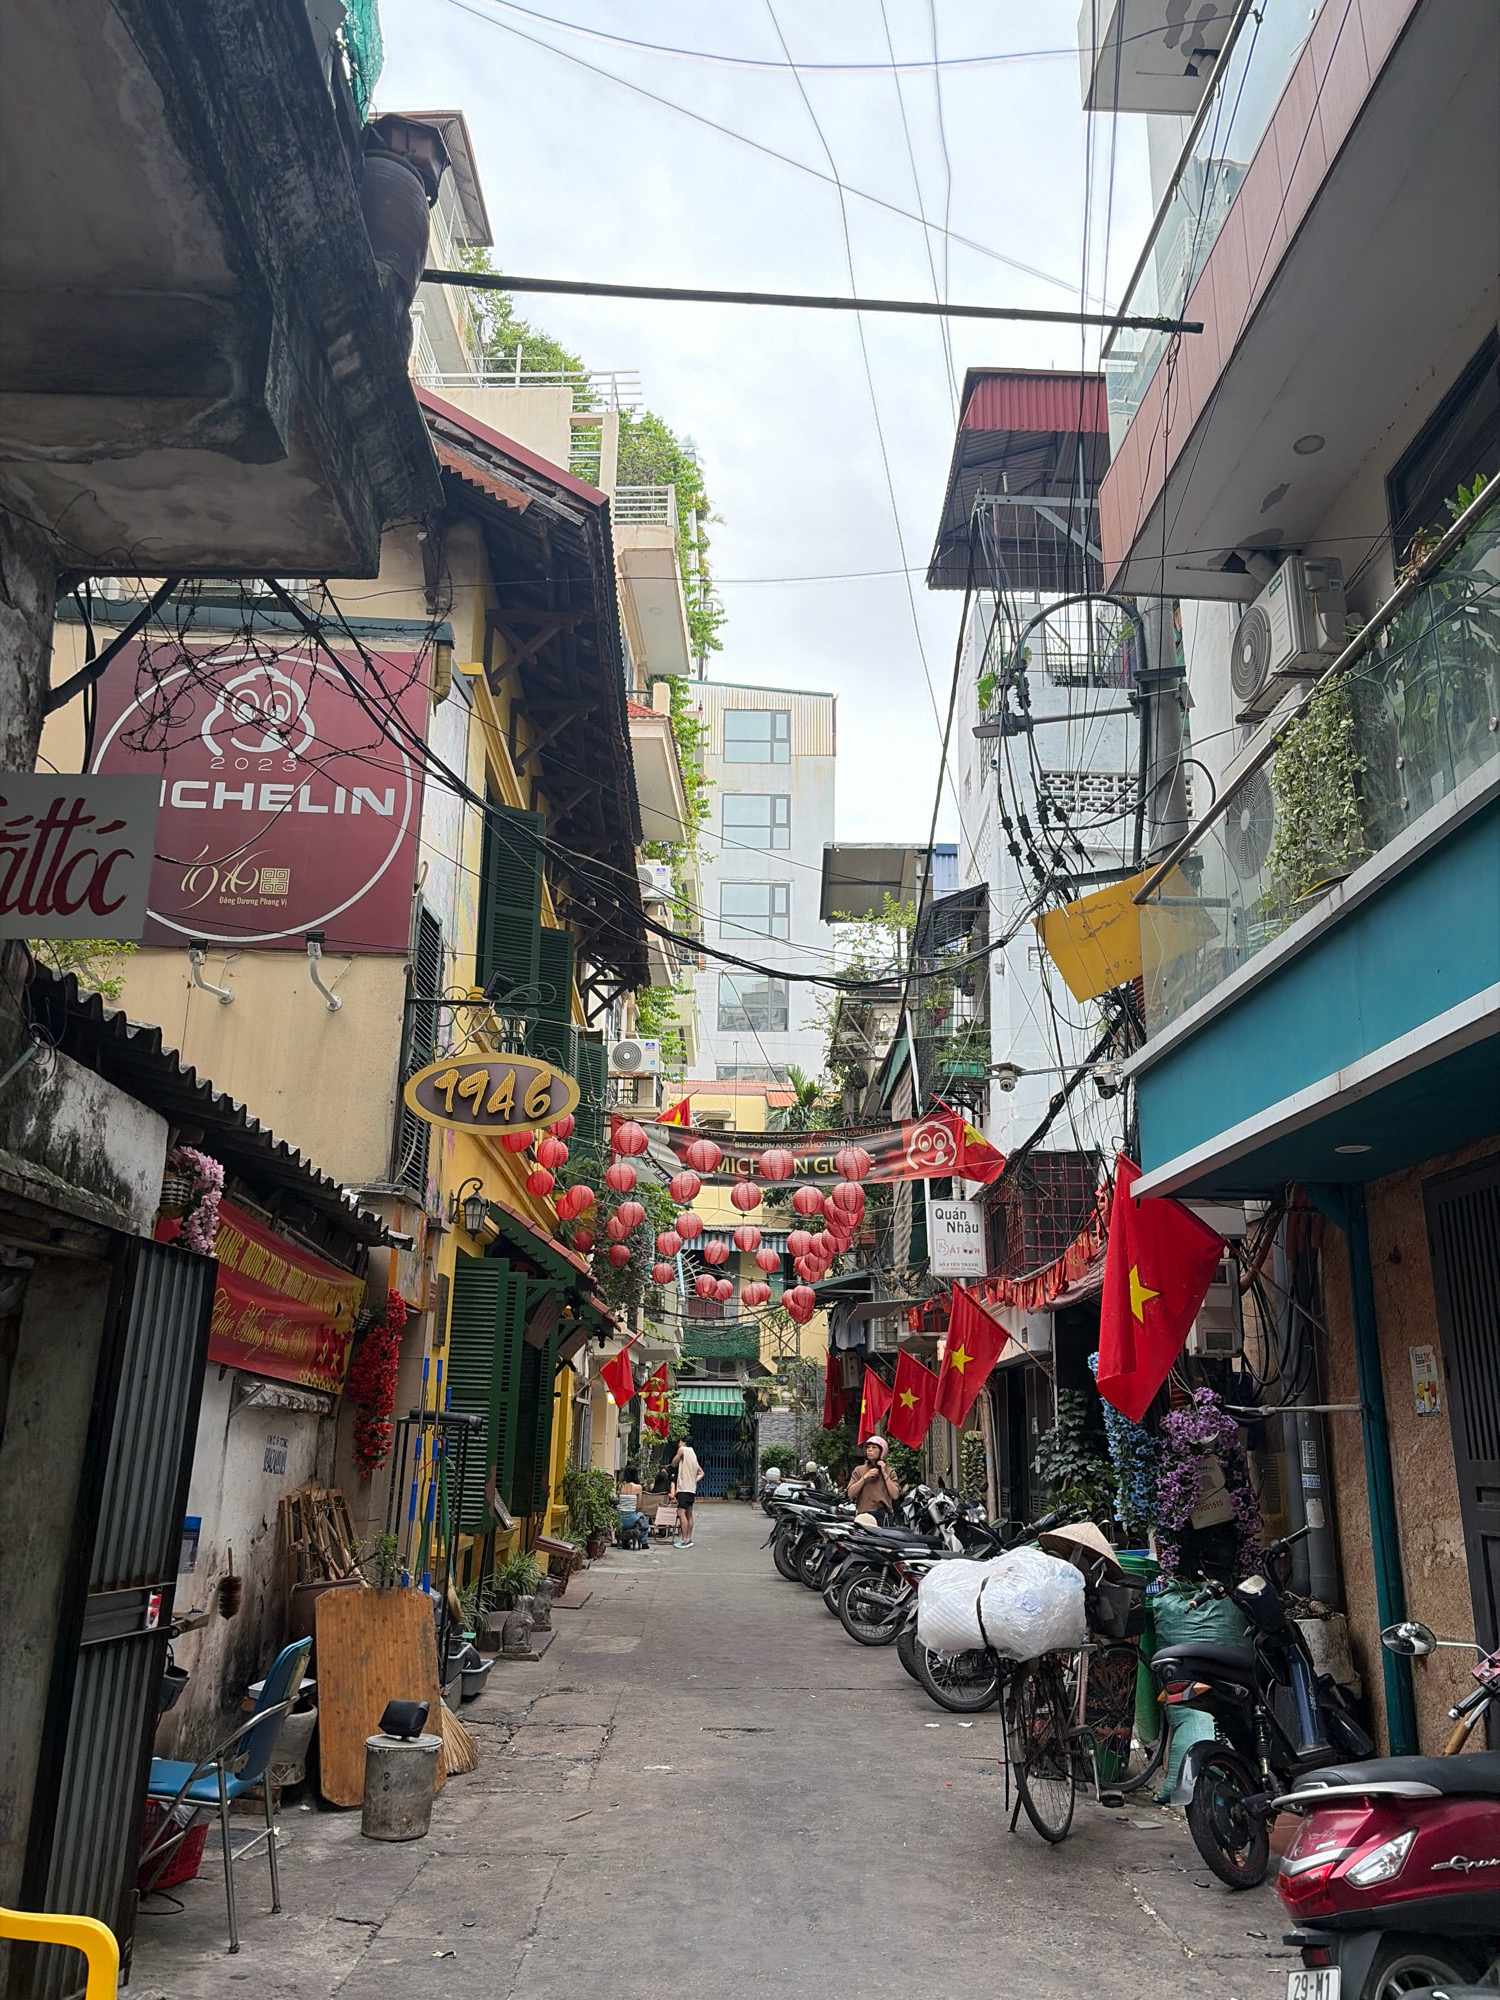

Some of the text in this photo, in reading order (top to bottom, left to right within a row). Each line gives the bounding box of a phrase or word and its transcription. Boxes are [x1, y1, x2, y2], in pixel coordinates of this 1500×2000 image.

[210, 757, 297, 772] 2023
[159, 779, 396, 816] CHELIN
[259, 897, 280, 906] Phong
[434, 1068, 552, 1121] 1946
[734, 1141, 747, 1149] BIB
[810, 1140, 839, 1149] HOSTED
[935, 1207, 967, 1220] Quán
[946, 1221, 979, 1236] Nhậu
